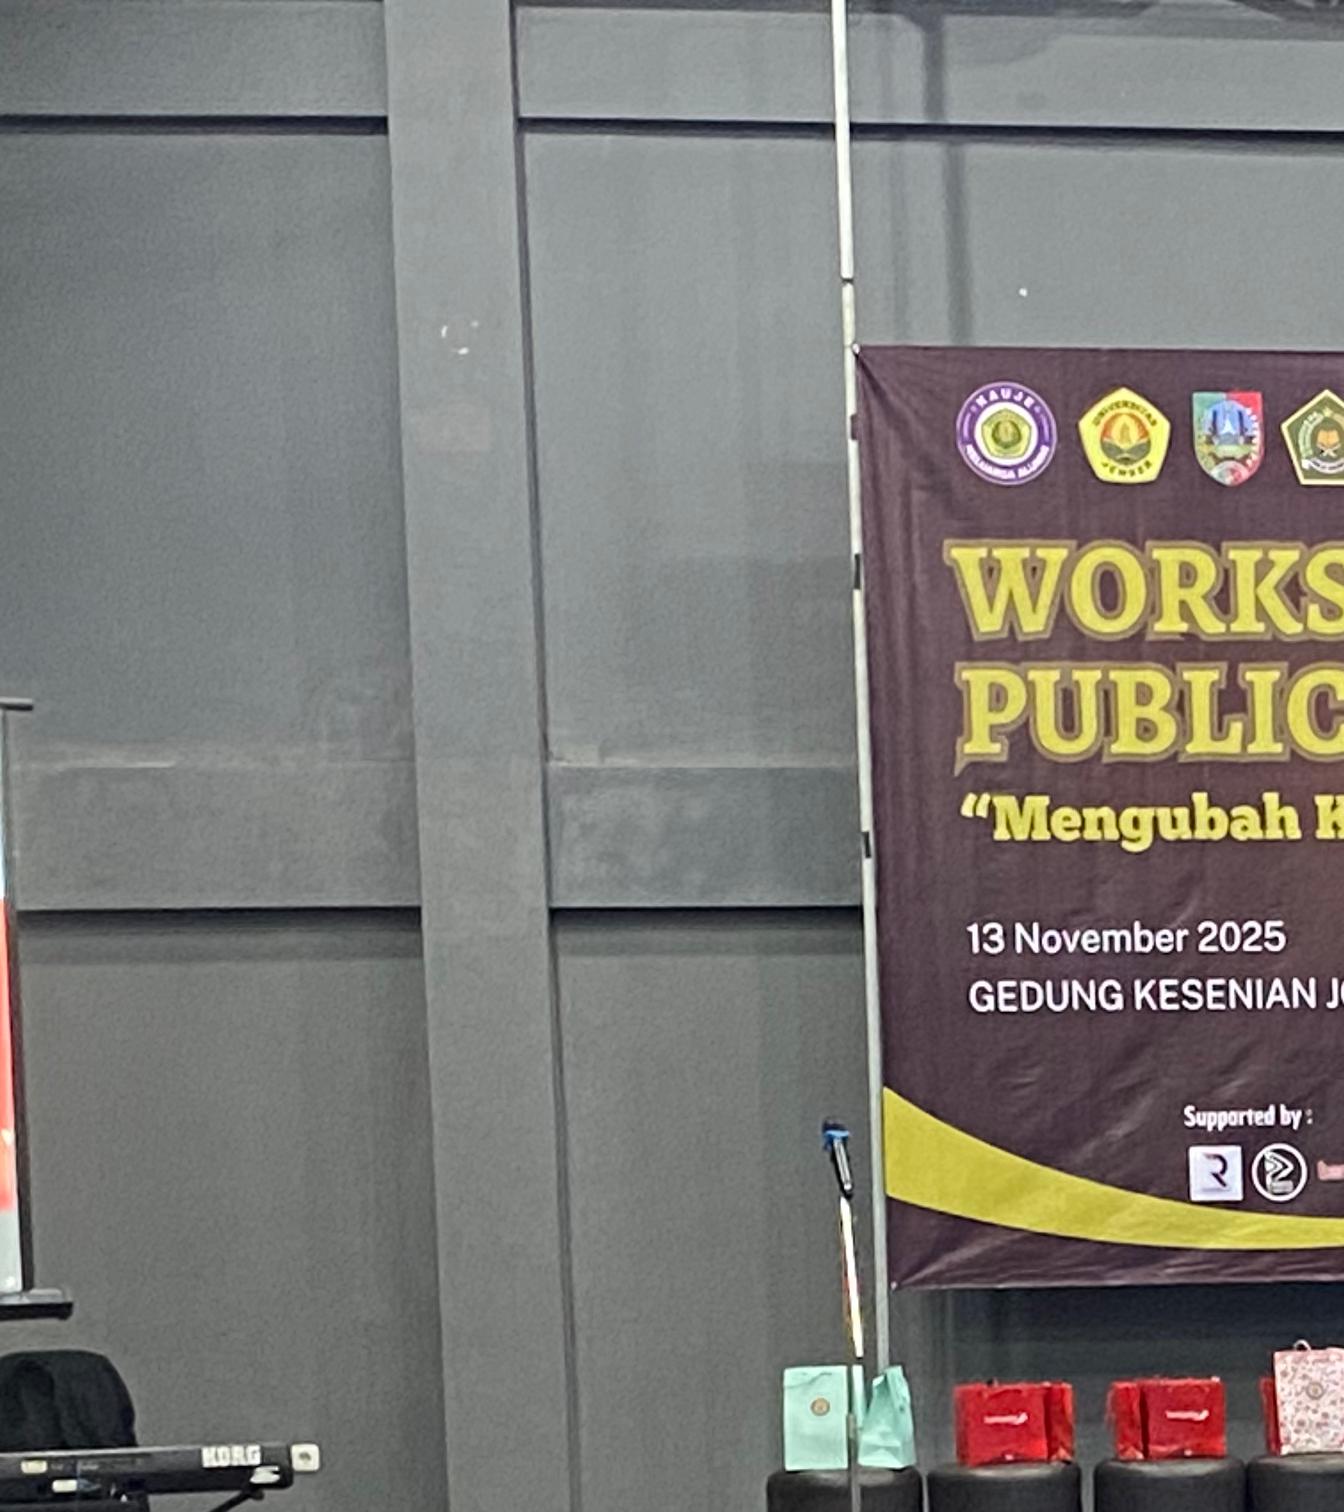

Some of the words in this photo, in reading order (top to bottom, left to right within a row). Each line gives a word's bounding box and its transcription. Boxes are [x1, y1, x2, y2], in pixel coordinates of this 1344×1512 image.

[976, 387, 1035, 410] KAUJE
[961, 791, 1302, 853] “Mengubah
[966, 921, 1005, 955] 13
[1014, 920, 1190, 955] November
[1197, 920, 1288, 954] 2025
[968, 978, 1125, 1013] GEDUNG
[1133, 976, 1318, 1012] KESENIAN
[1183, 1104, 1276, 1132] Supported
[1277, 1105, 1303, 1131] by
[202, 1445, 262, 1469] KORG
